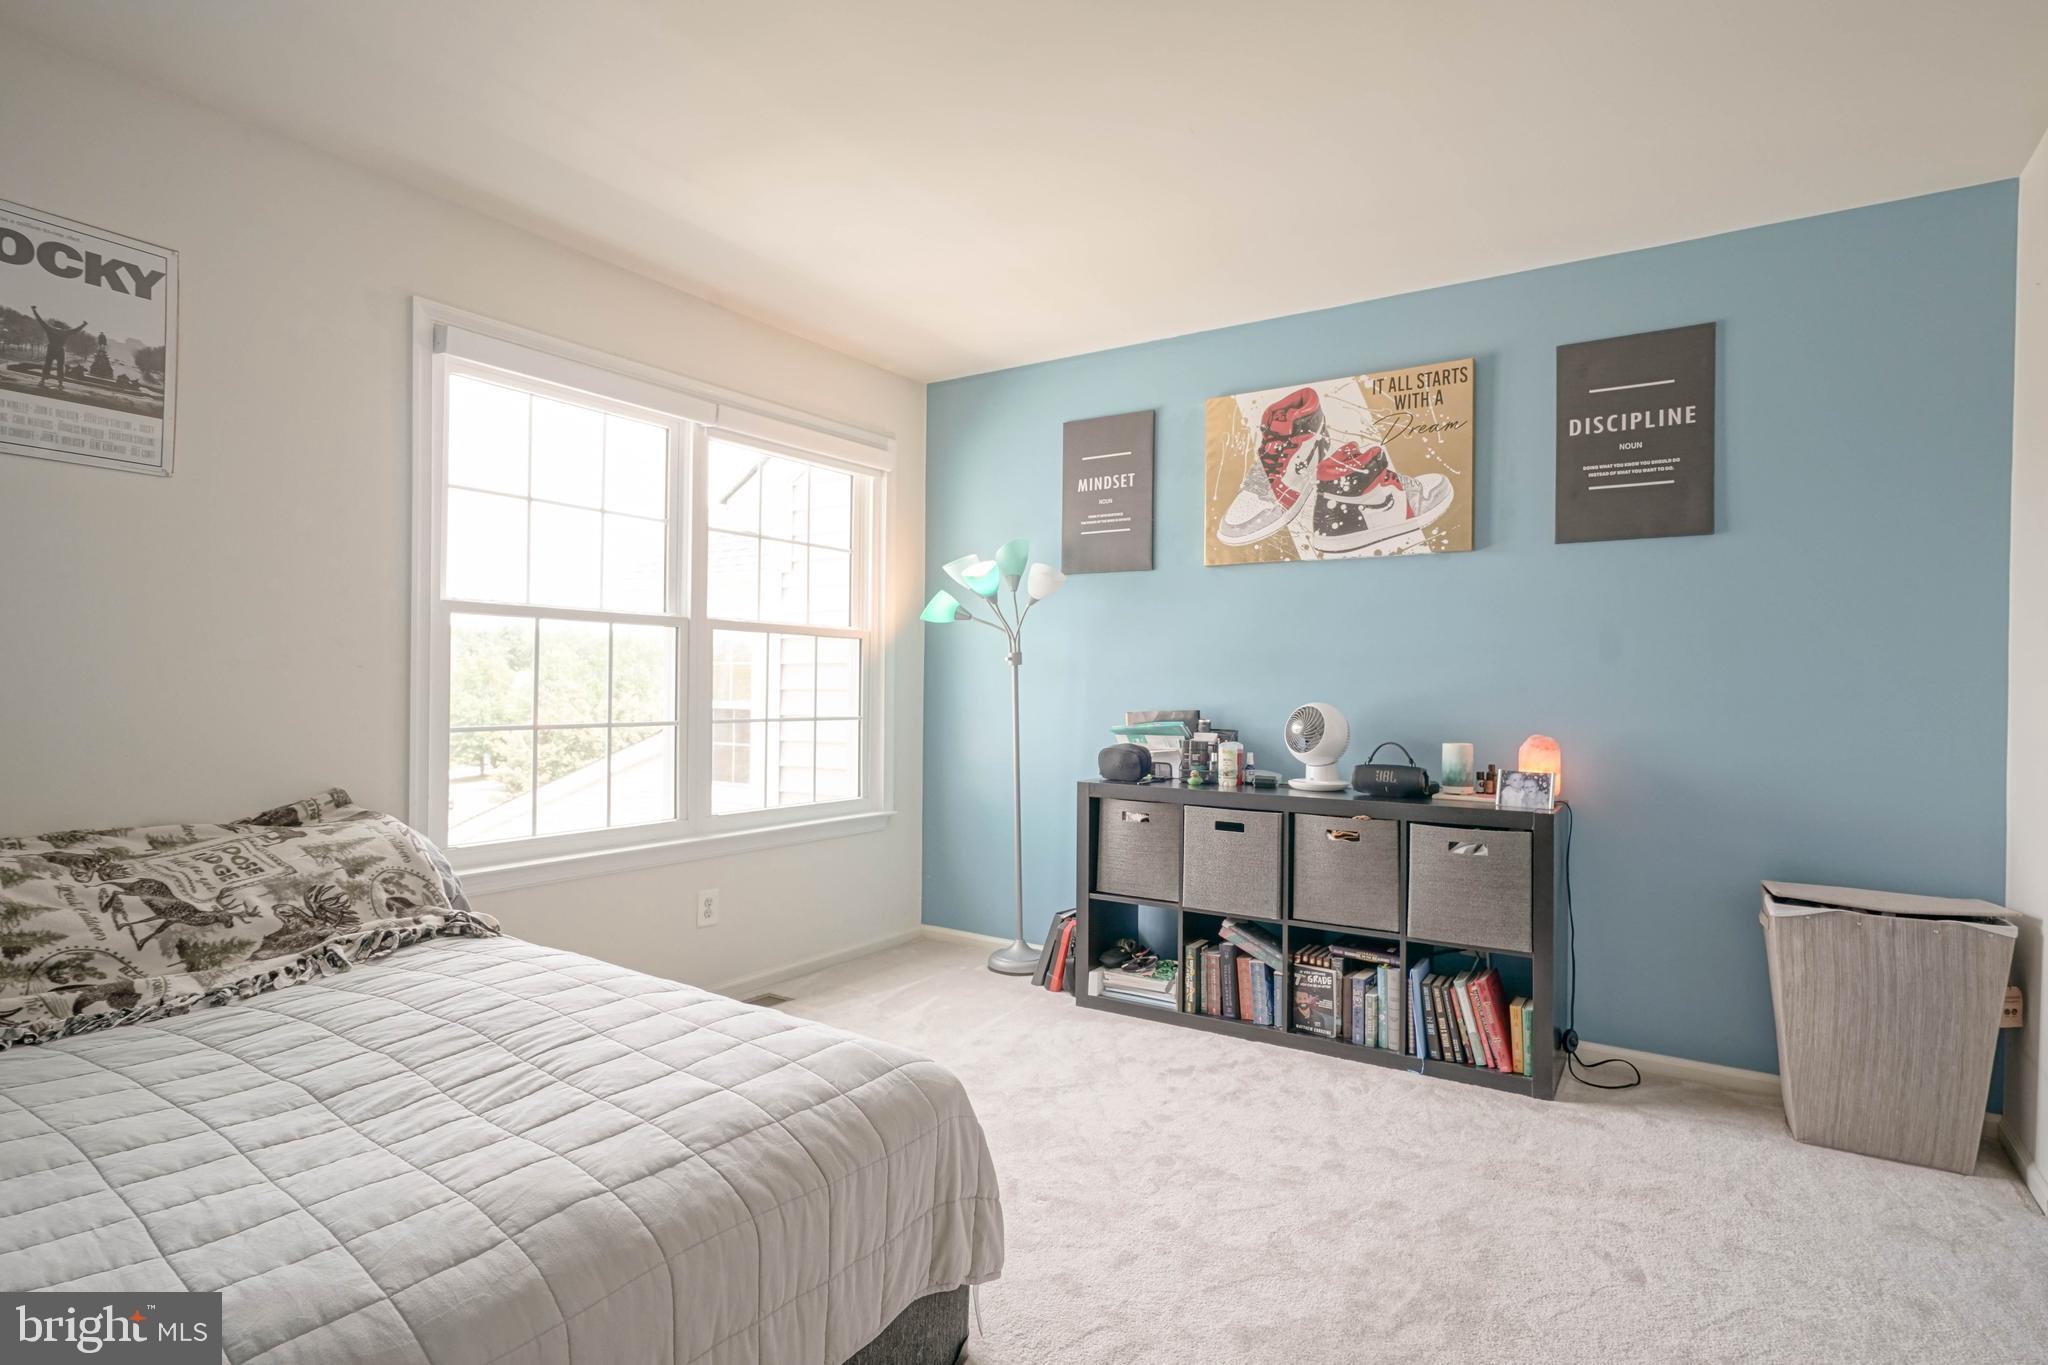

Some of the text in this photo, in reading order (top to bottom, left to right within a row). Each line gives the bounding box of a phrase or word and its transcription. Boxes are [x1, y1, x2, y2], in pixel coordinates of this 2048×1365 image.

[1372, 366, 1468, 395] IT ALL STARTS
[1394, 389, 1444, 410] WITH A
[1371, 412, 1468, 446] Dream
[1569, 405, 1697, 437] DISCIPLINE
[1619, 441, 1643, 450] NOUN
[1077, 473, 1135, 492] MINDSET
[1375, 769, 1397, 784] JBL
[1307, 974, 1332, 985] GRADE
